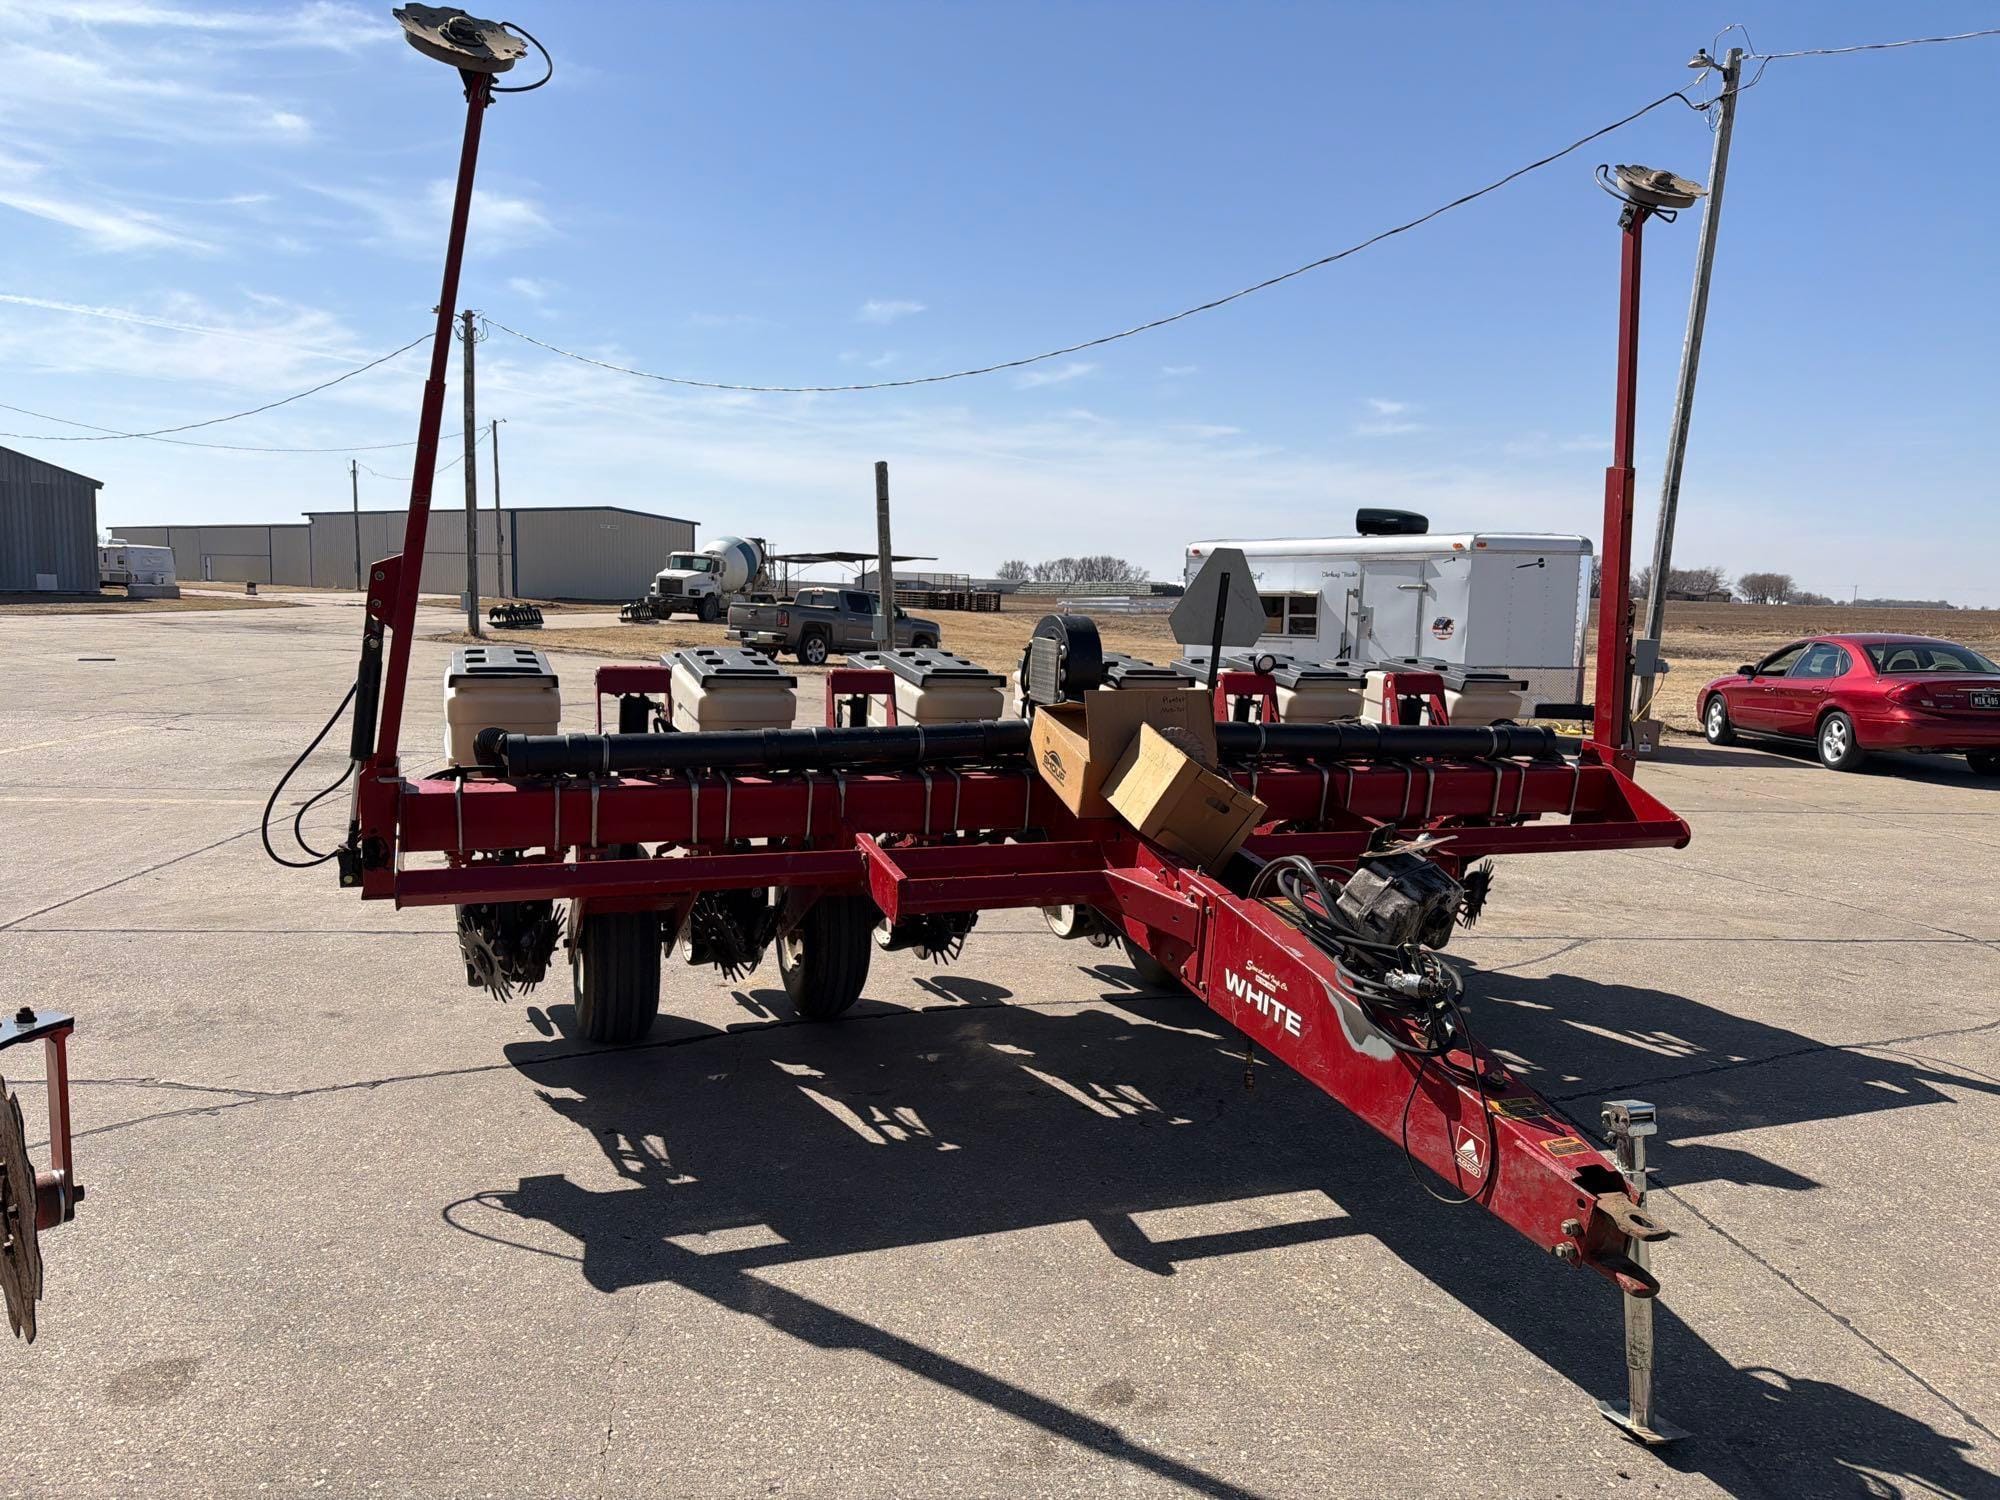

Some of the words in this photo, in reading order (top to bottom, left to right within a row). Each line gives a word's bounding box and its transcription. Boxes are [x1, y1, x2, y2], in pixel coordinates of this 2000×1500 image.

[1043, 754, 1066, 781] SHOUP
[1225, 967, 1302, 1038] WHITE
[1456, 1157, 1479, 1175] AGCO
